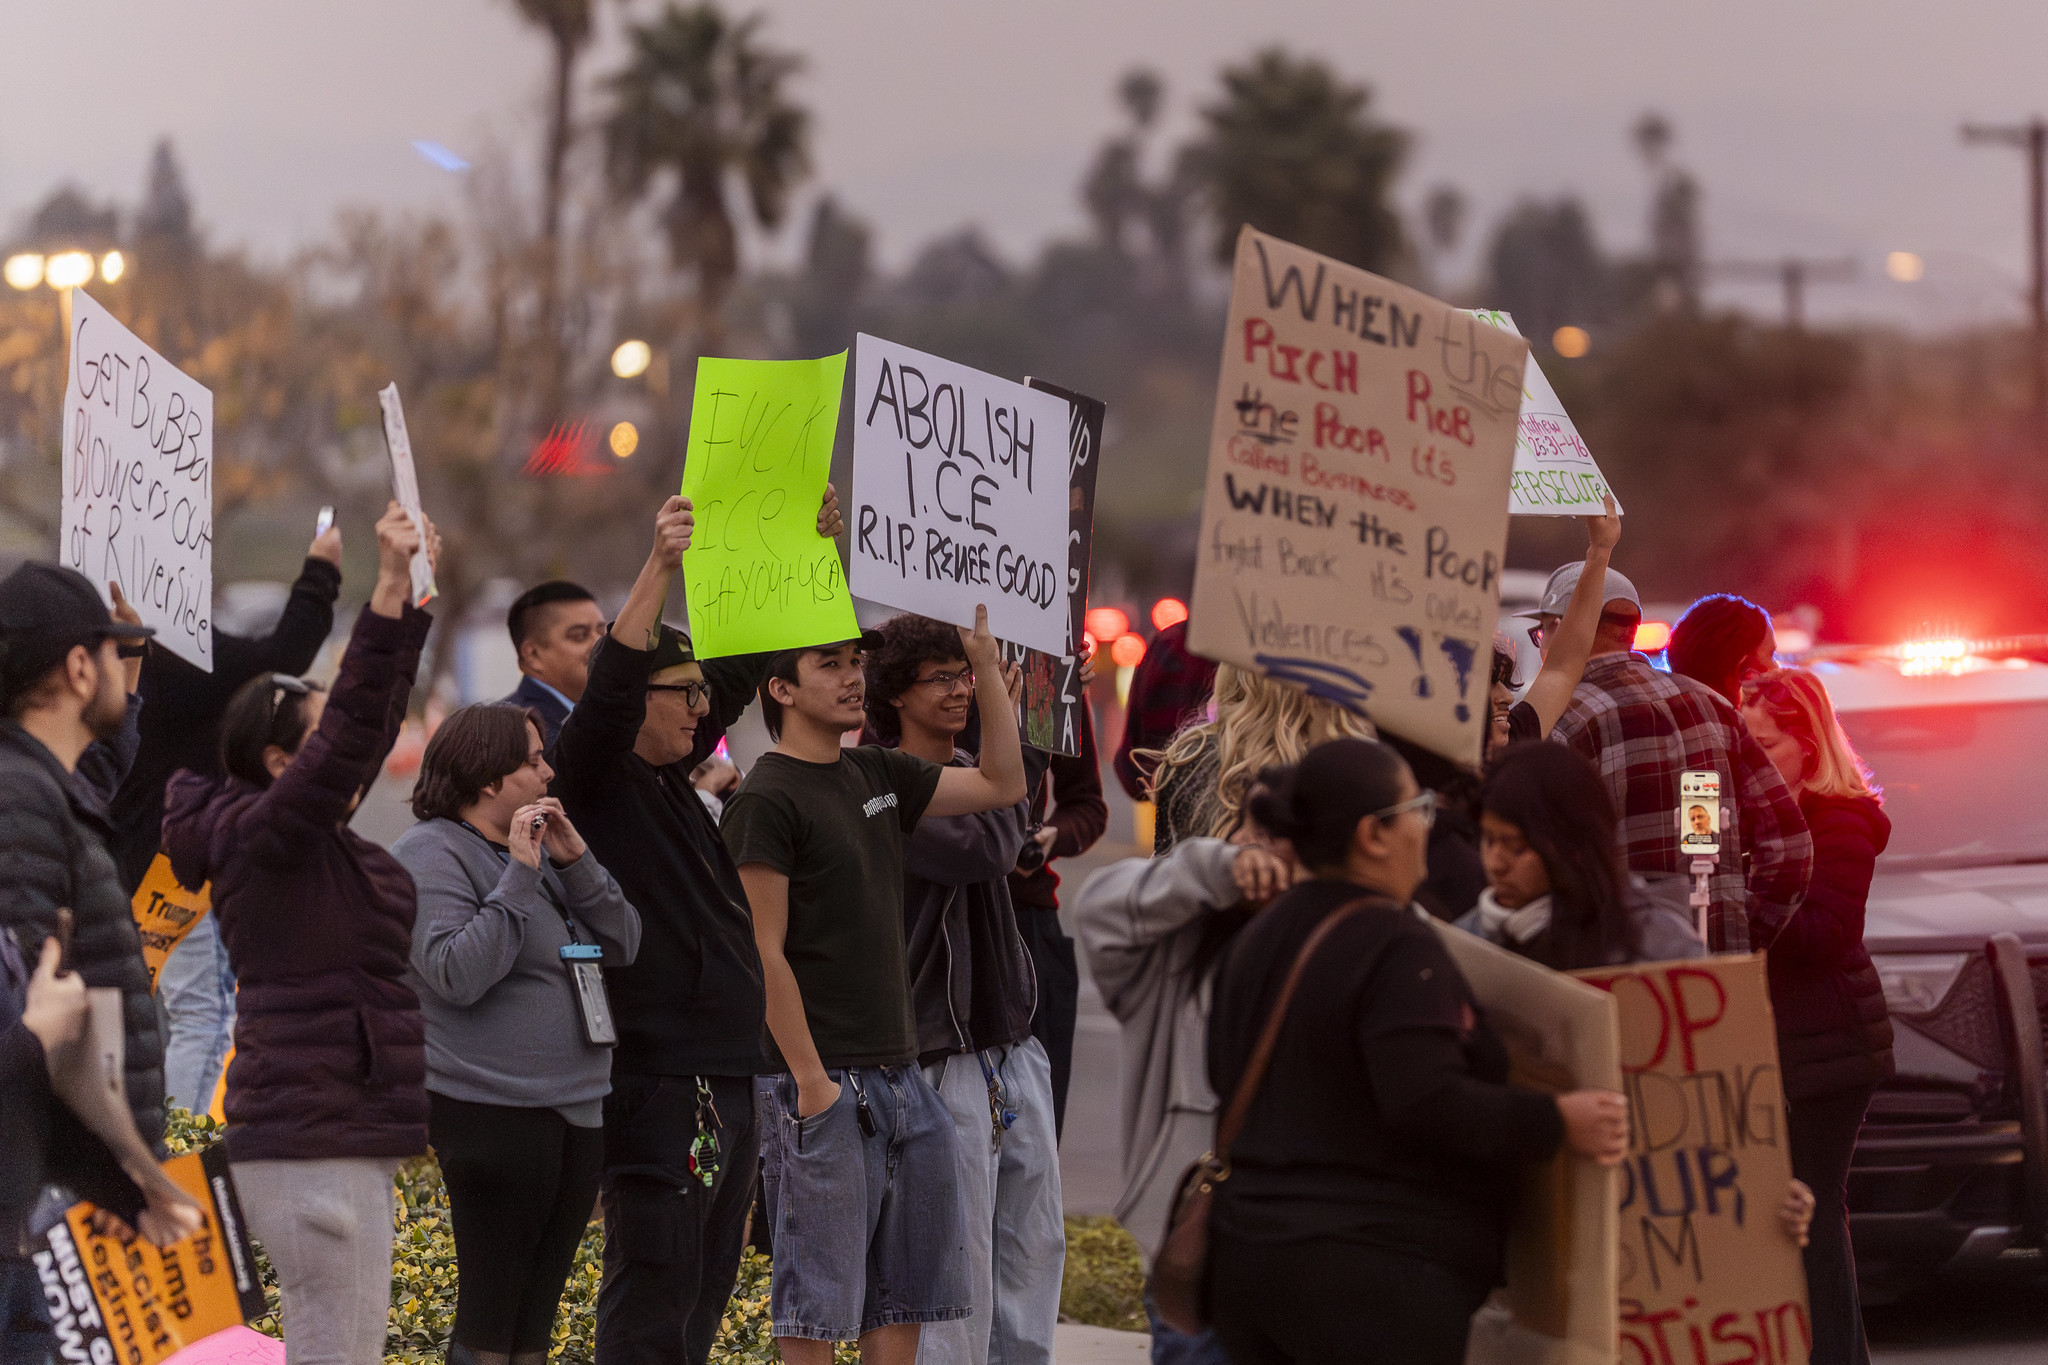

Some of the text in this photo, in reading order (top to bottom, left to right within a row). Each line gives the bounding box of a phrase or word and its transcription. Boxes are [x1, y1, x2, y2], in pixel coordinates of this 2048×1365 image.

[1254, 239, 1524, 415] WHEN the
[703, 388, 827, 481] FUCK
[866, 357, 1034, 495] ABOLISH
[1235, 383, 1298, 436] the
[72, 407, 170, 521] Blowers
[70, 505, 92, 575] of
[1224, 473, 1337, 529] WHEN
[1349, 512, 1407, 556] the
[926, 527, 991, 587] RENEE
[996, 543, 1056, 611] GOOD
[47, 1222, 102, 1330] MUST
